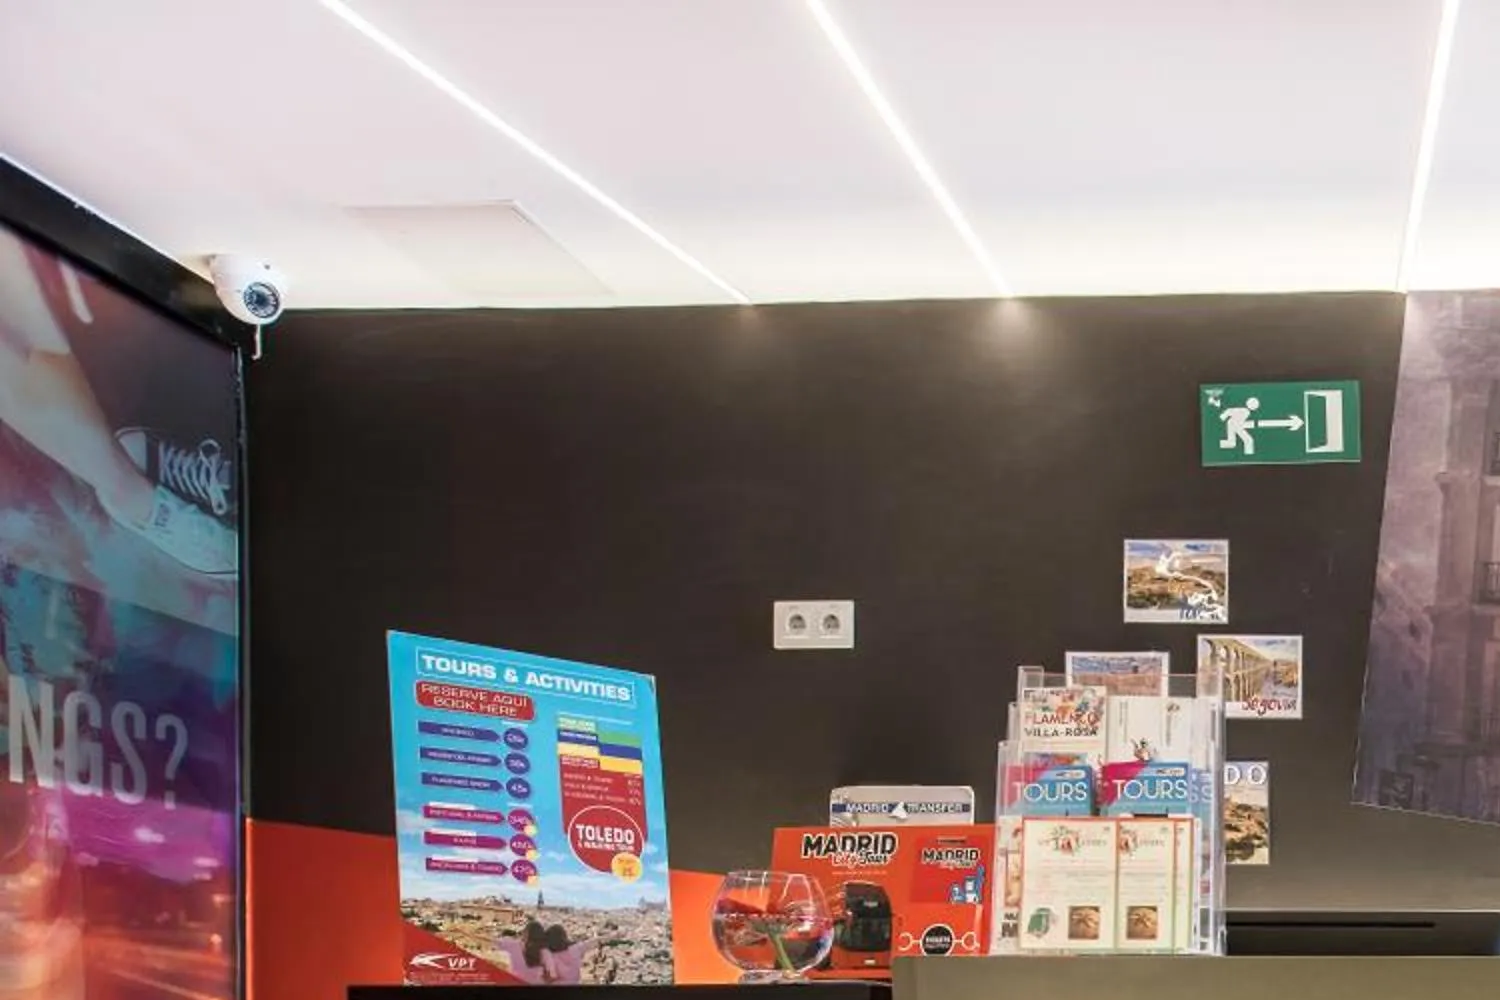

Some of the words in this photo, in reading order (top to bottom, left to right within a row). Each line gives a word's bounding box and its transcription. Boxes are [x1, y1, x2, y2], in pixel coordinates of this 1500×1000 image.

[421, 654, 497, 679] TOURS
[503, 668, 518, 683] &
[525, 671, 631, 701] ACTIVITIES
[421, 683, 488, 701] RESERVE
[433, 696, 475, 711] BOOK
[480, 703, 518, 717] HERE
[9, 674, 188, 810] NGS?
[1024, 727, 1099, 738] VILLA-ROSA
[1013, 782, 1088, 801] TOURS
[1112, 779, 1188, 800] TOURS
[845, 803, 889, 814] MADRID
[907, 803, 964, 814] TRANSFER
[575, 824, 635, 845] TOLEDO
[802, 832, 898, 858] MADRID
[922, 848, 981, 862] MADRID
[448, 958, 476, 969] VPT
